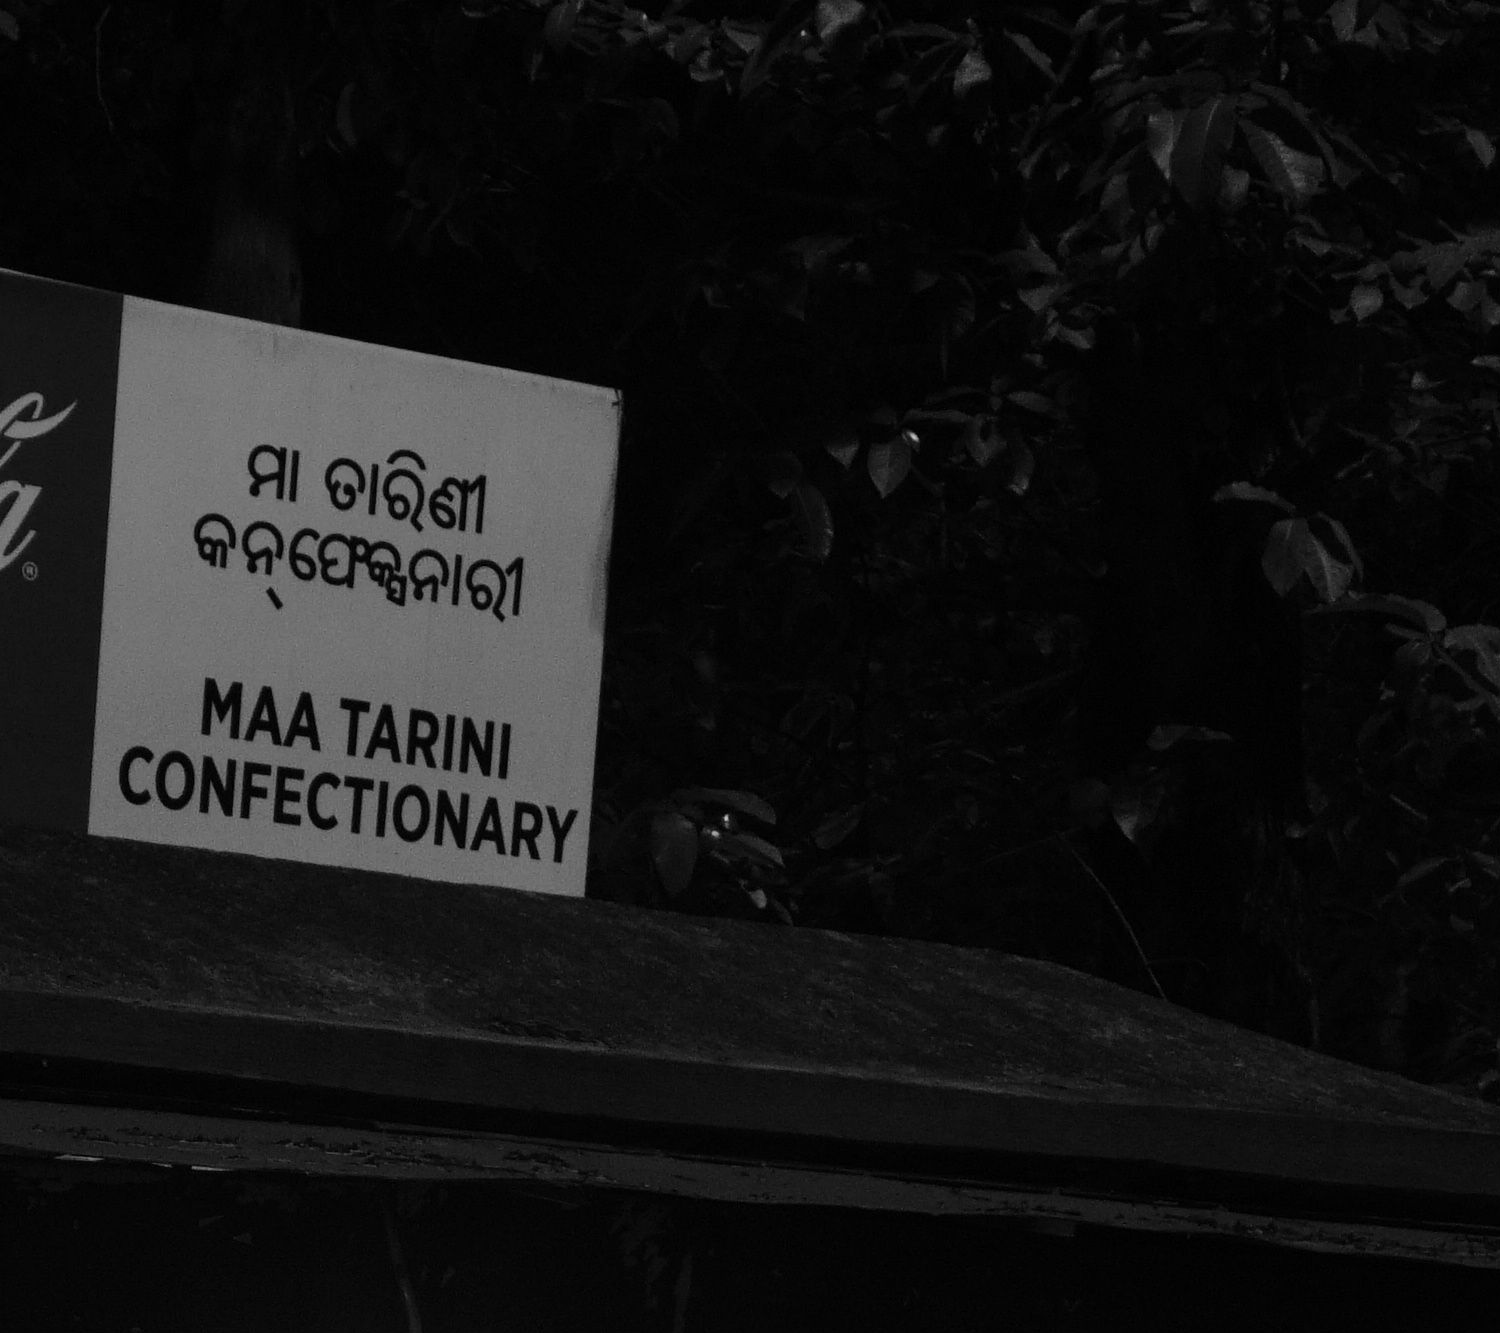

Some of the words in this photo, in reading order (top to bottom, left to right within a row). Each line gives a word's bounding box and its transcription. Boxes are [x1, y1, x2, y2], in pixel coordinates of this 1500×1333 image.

[247, 443, 300, 502] ମା
[325, 449, 487, 534] ତାରିଣୀ
[200, 676, 322, 752] MAA
[340, 697, 512, 780] TARINI
[118, 745, 579, 864] CONFECTIONARY
